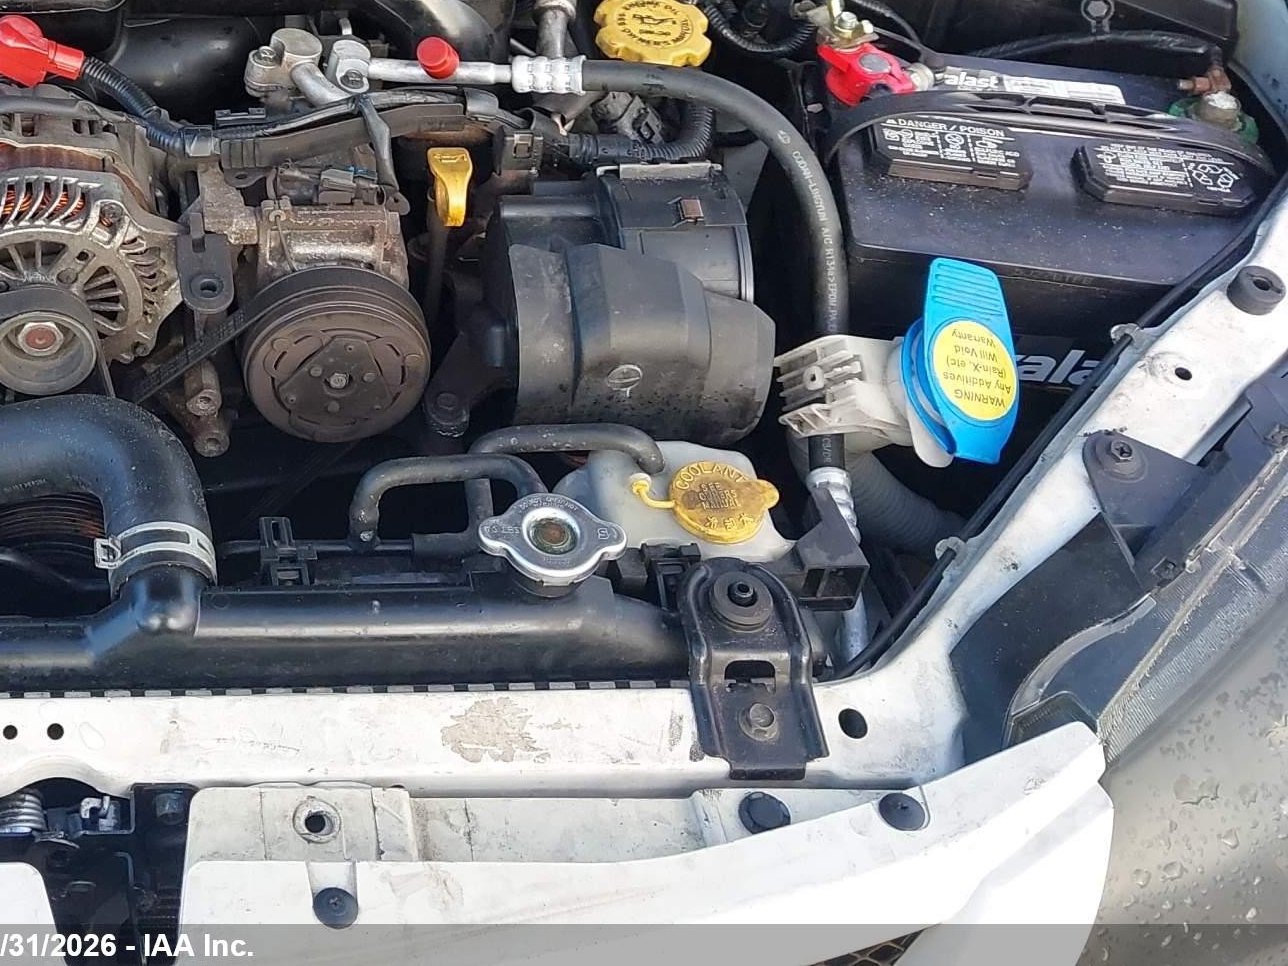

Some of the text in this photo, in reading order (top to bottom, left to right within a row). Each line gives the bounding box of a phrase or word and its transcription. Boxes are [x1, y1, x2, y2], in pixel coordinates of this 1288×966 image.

[664, 4, 680, 15] OIL
[936, 71, 999, 89] alast
[898, 118, 947, 131] DANGER
[959, 125, 1005, 137] POISON
[952, 328, 997, 348] Warranty
[946, 355, 966, 368] etc)
[954, 344, 998, 363] Will Void
[943, 371, 1011, 395] Any Additives
[954, 389, 1006, 408] WARNING
[675, 462, 750, 490] COOLANT
[700, 482, 722, 492] SEE
[702, 498, 742, 510] MANUAL
